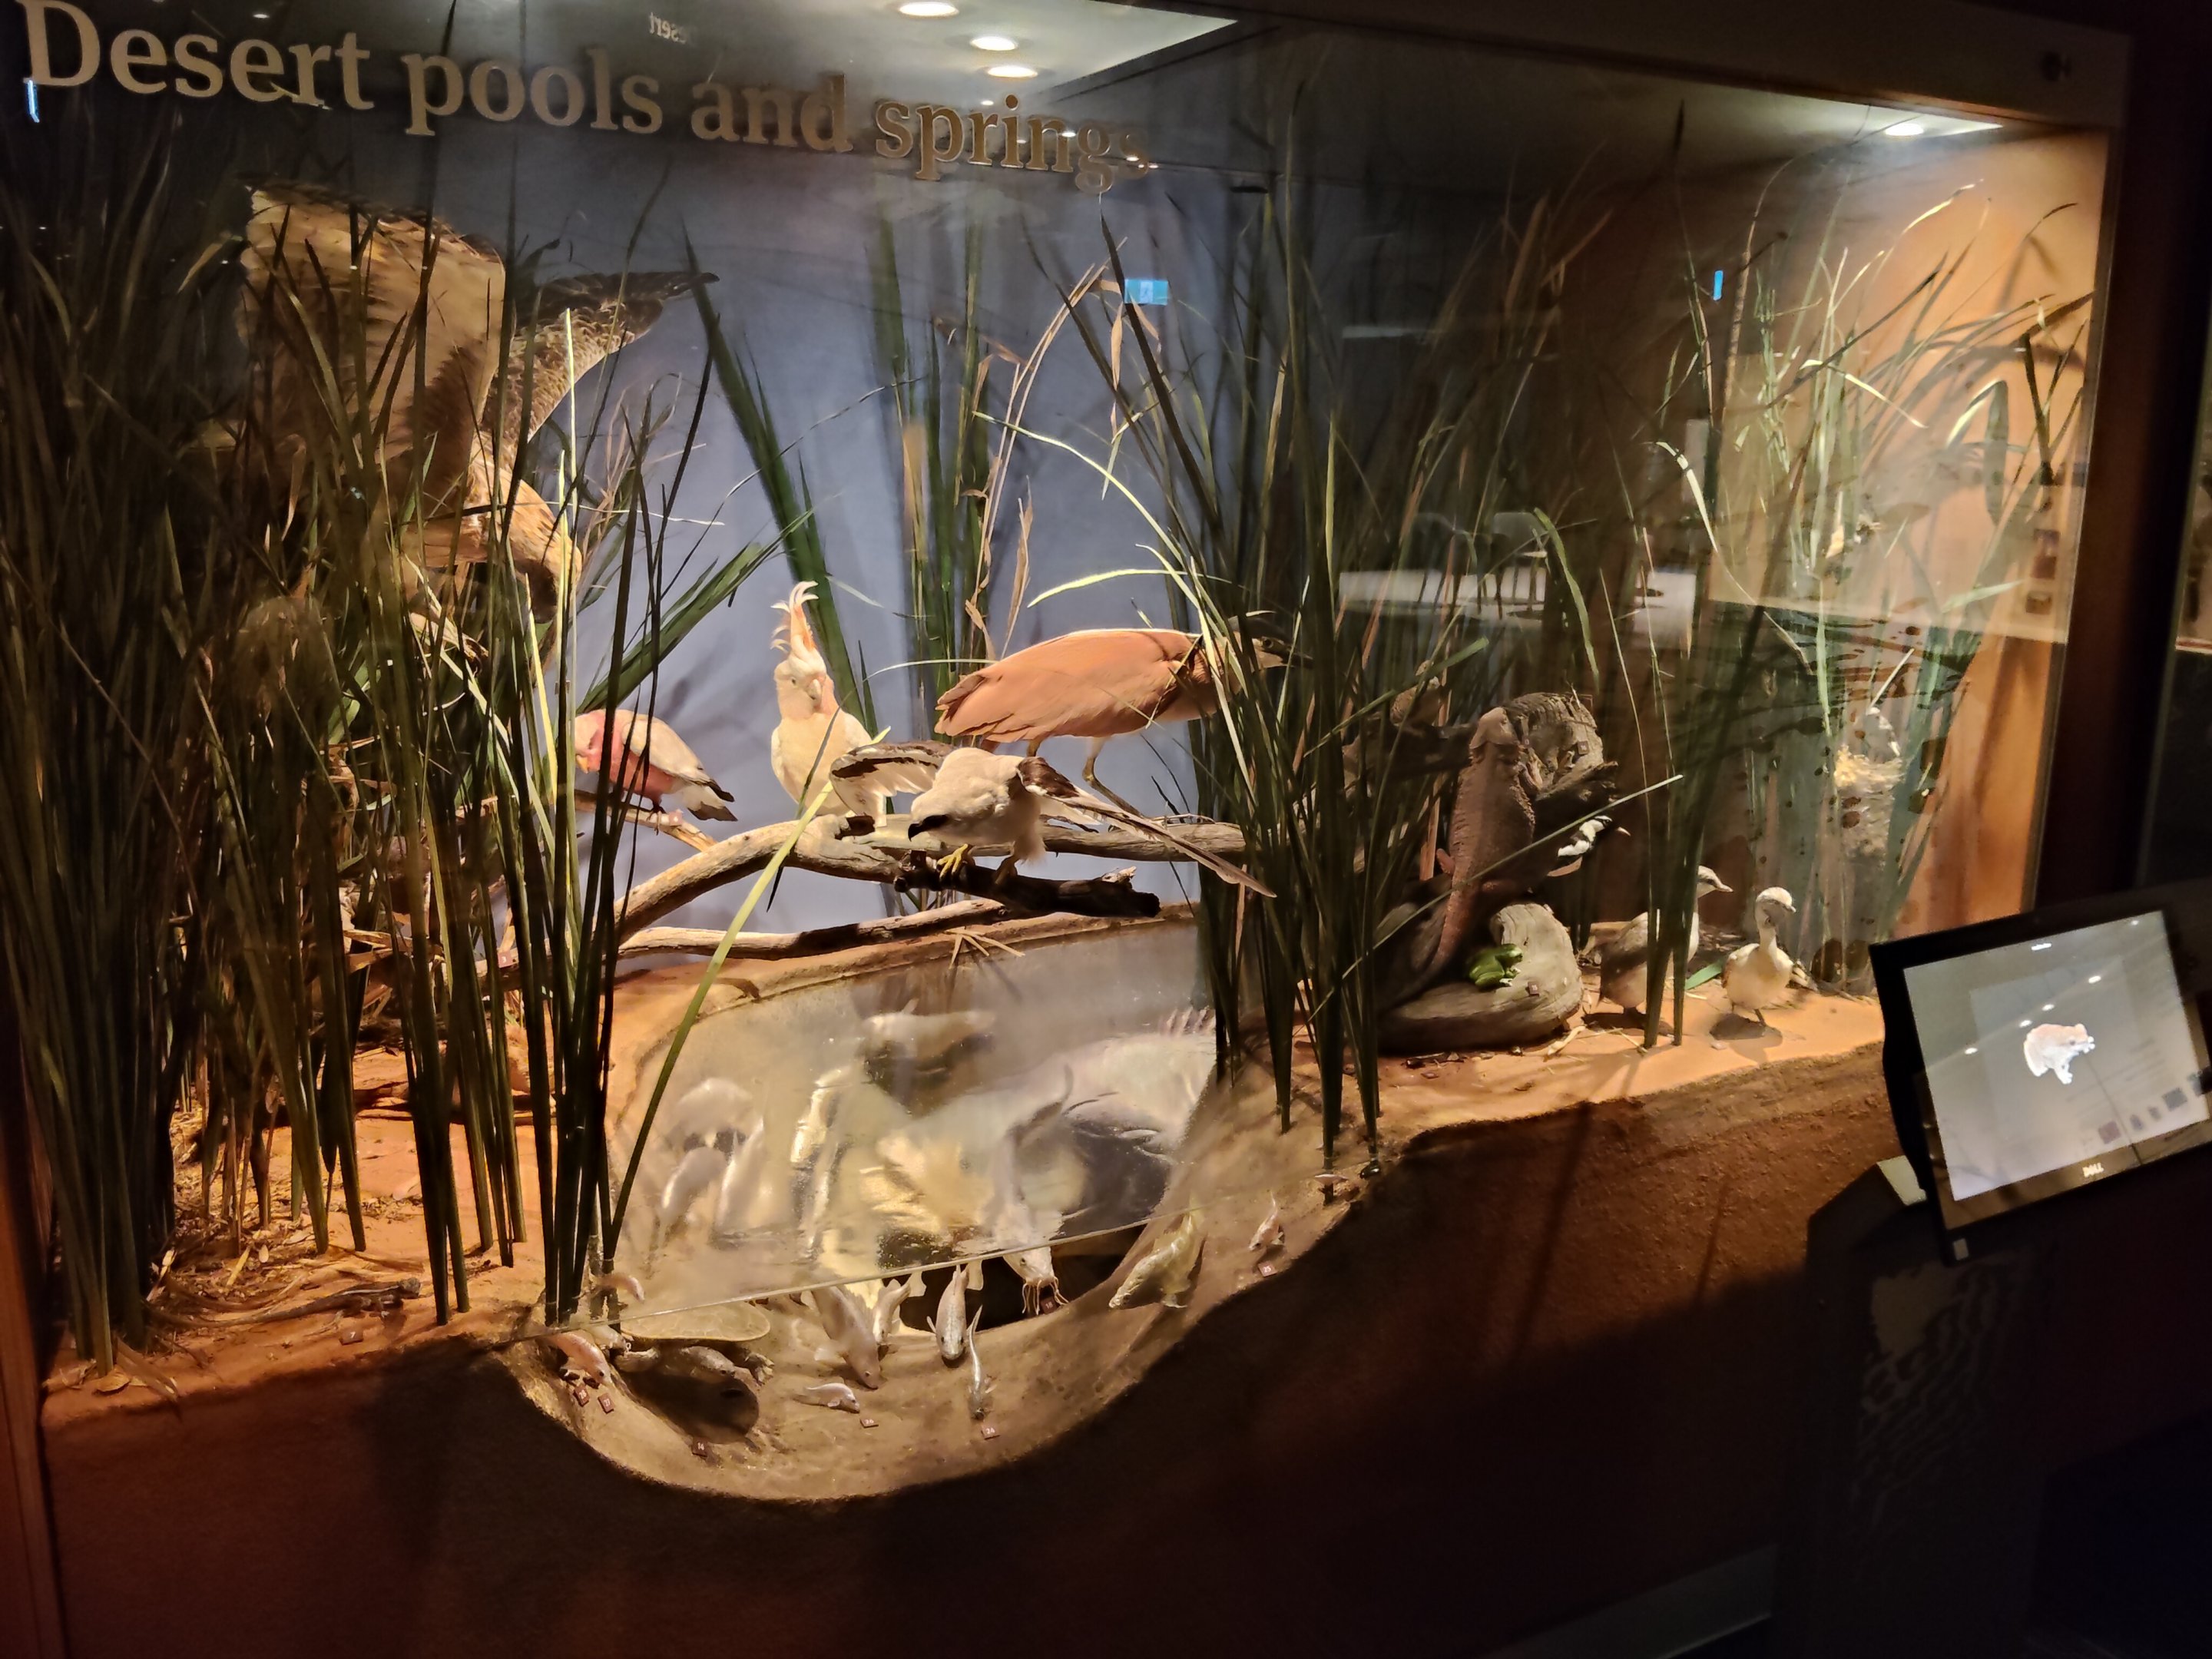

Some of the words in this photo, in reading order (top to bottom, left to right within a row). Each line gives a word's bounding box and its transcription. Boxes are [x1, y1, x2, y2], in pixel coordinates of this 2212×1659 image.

[15, 0, 375, 110] Desert
[401, 48, 664, 136] pools
[690, 73, 854, 154] and
[874, 94, 1151, 195] springs
[697, 1442, 705, 1451] 14
